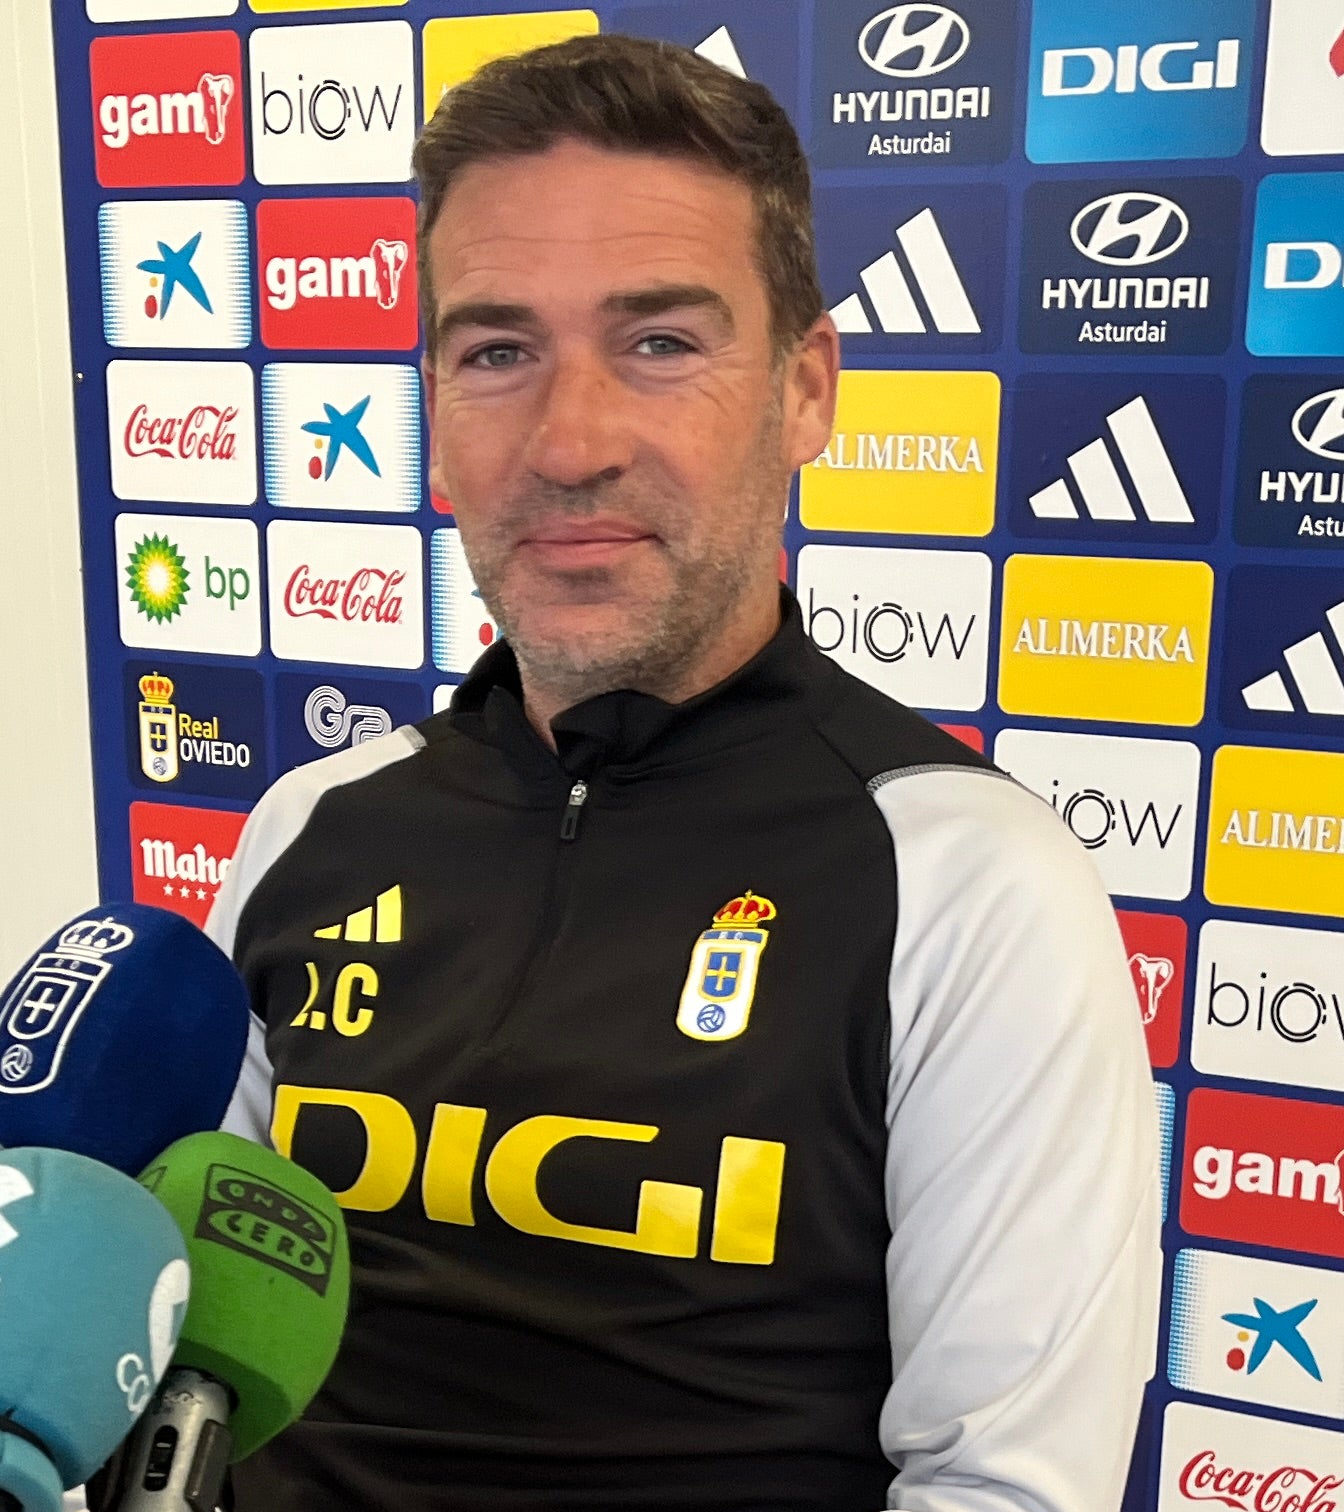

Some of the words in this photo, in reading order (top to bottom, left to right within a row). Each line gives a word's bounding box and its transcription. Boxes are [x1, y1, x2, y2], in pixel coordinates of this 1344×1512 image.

[1041, 39, 1239, 96] DIGI
[100, 92, 205, 148] gam
[261, 71, 402, 141] biow
[833, 87, 991, 123] HYUNDAI
[867, 131, 951, 156] Asturdai
[265, 251, 377, 310] gam
[1042, 277, 1208, 310] HYUNDAI
[1078, 321, 1166, 344] Asturdai
[123, 404, 240, 461] Coca-Cola
[204, 556, 250, 610] bp
[283, 565, 409, 625] Coca-Cola
[809, 588, 976, 662] biow
[1013, 617, 1194, 663] ALIMERKA
[179, 713, 218, 738] Real
[179, 734, 250, 767] OVIEDO
[1053, 780, 1182, 849] ow
[271, 1084, 785, 1265] DIGI
[1193, 1145, 1338, 1205] gam
[228, 1182, 319, 1233] ONDA
[226, 1213, 315, 1267] CERO
